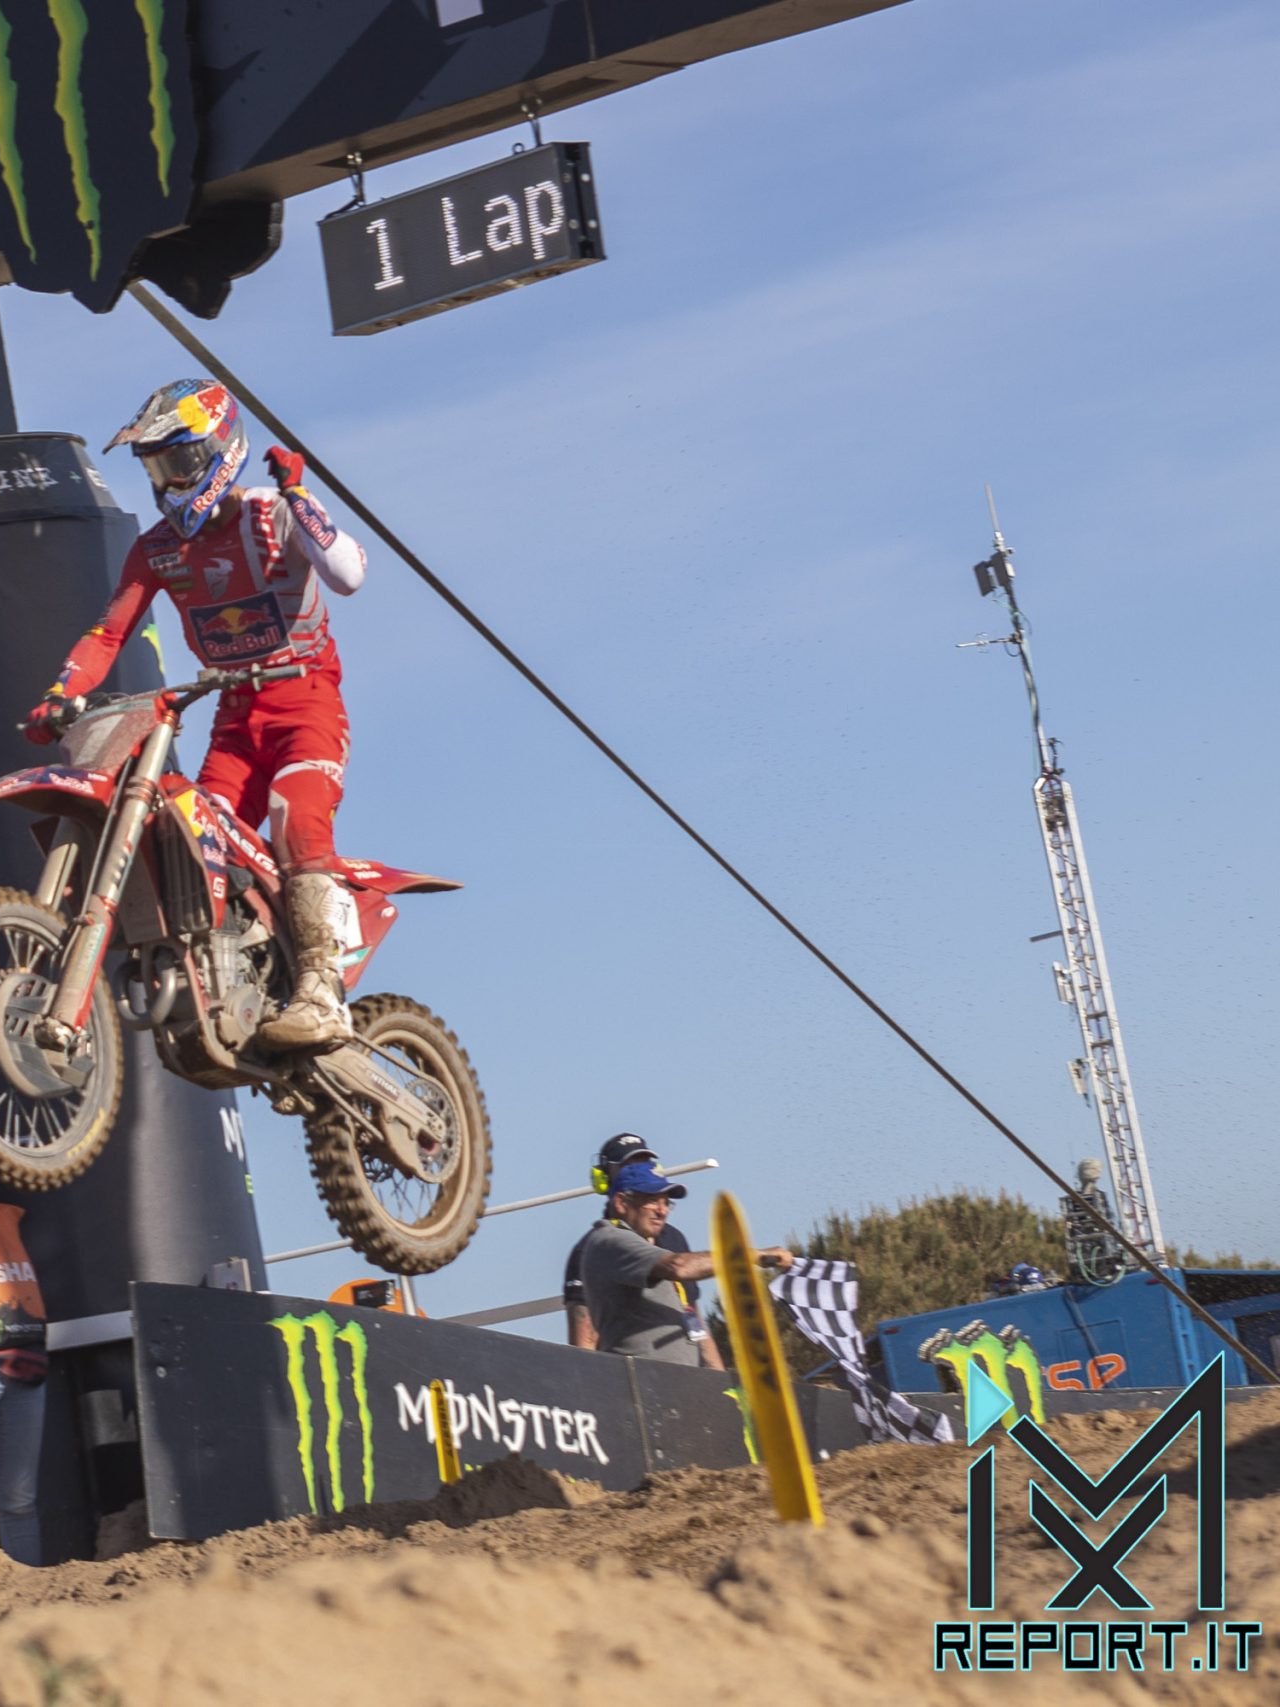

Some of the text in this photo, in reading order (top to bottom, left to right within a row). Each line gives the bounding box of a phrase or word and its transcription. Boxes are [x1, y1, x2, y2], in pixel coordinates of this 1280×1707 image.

[366, 180, 565, 290] 1 Lap
[204, 626, 281, 658] Red Bull
